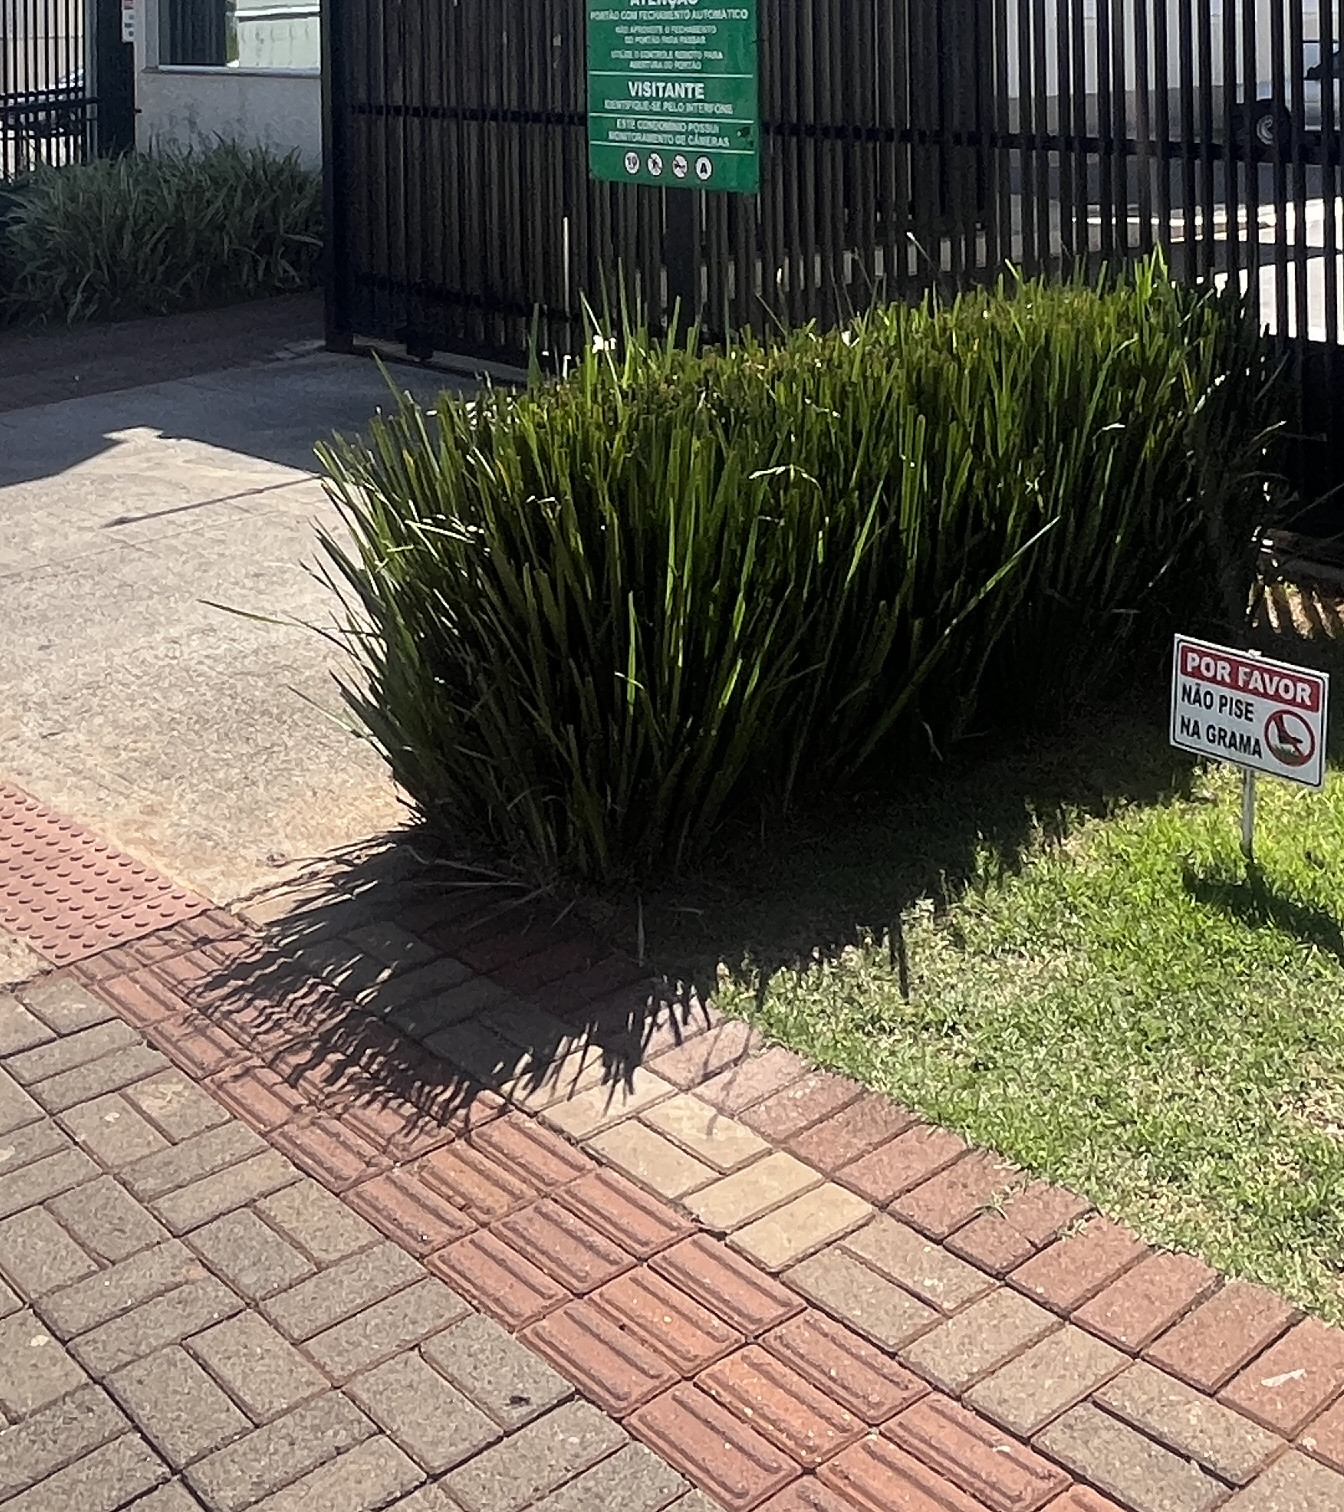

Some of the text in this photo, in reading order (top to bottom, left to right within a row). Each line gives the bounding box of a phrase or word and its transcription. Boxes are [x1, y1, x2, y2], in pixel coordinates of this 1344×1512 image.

[591, 8, 748, 20] PORTÃO COM FECHAMENTO AUTOMÁTICO
[628, 81, 705, 100] VISITANTE
[604, 99, 733, 114] IDENTIFIQUE-SE PELO INTERFONE
[616, 119, 635, 129] ESTE
[688, 123, 719, 133] POSSUI
[608, 131, 730, 147] MONITORAMENTO DE CÂMERAS
[1186, 652, 1312, 706] POR FAVOR
[1181, 682, 1255, 723] NÃO PISE
[1180, 715, 1263, 759] NA GRAMA
